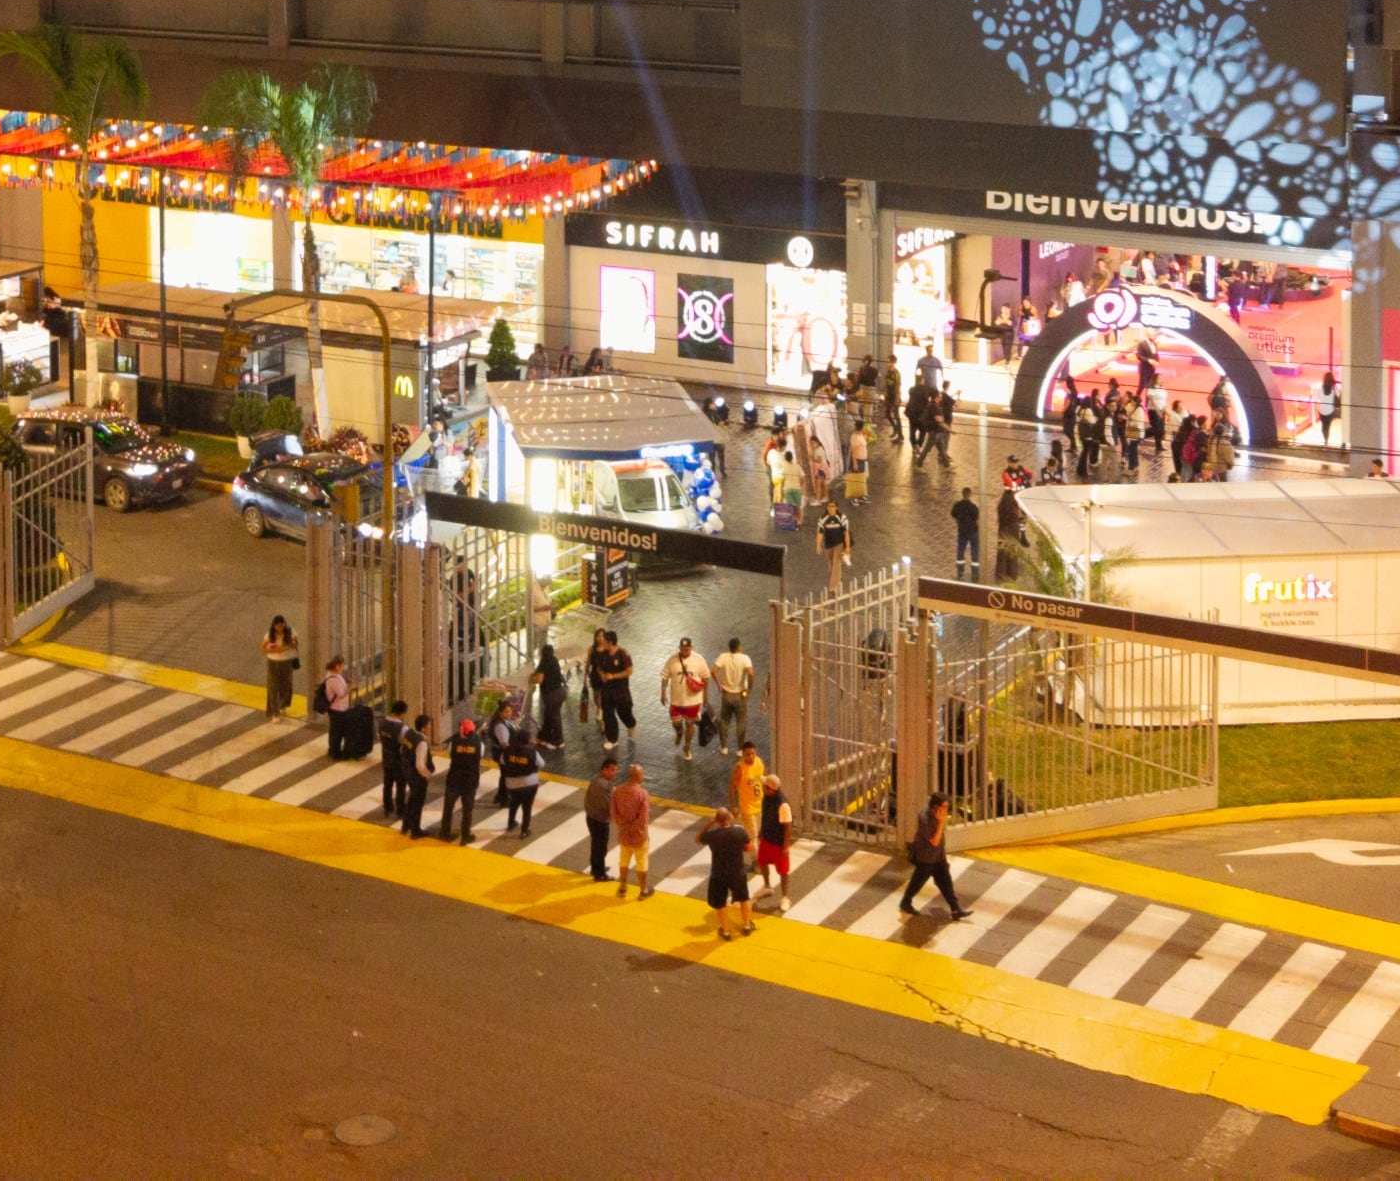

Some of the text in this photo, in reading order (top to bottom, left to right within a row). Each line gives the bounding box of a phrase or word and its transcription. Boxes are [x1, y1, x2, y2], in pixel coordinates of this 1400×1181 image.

[605, 221, 720, 254] SIFRAH
[1256, 340, 1295, 355] utlets
[539, 518, 658, 551] Bienvenidos!
[590, 561, 598, 604] TAXI
[1245, 573, 1334, 603] frutix
[1011, 594, 1033, 611] No
[1037, 602, 1083, 618] pasar
